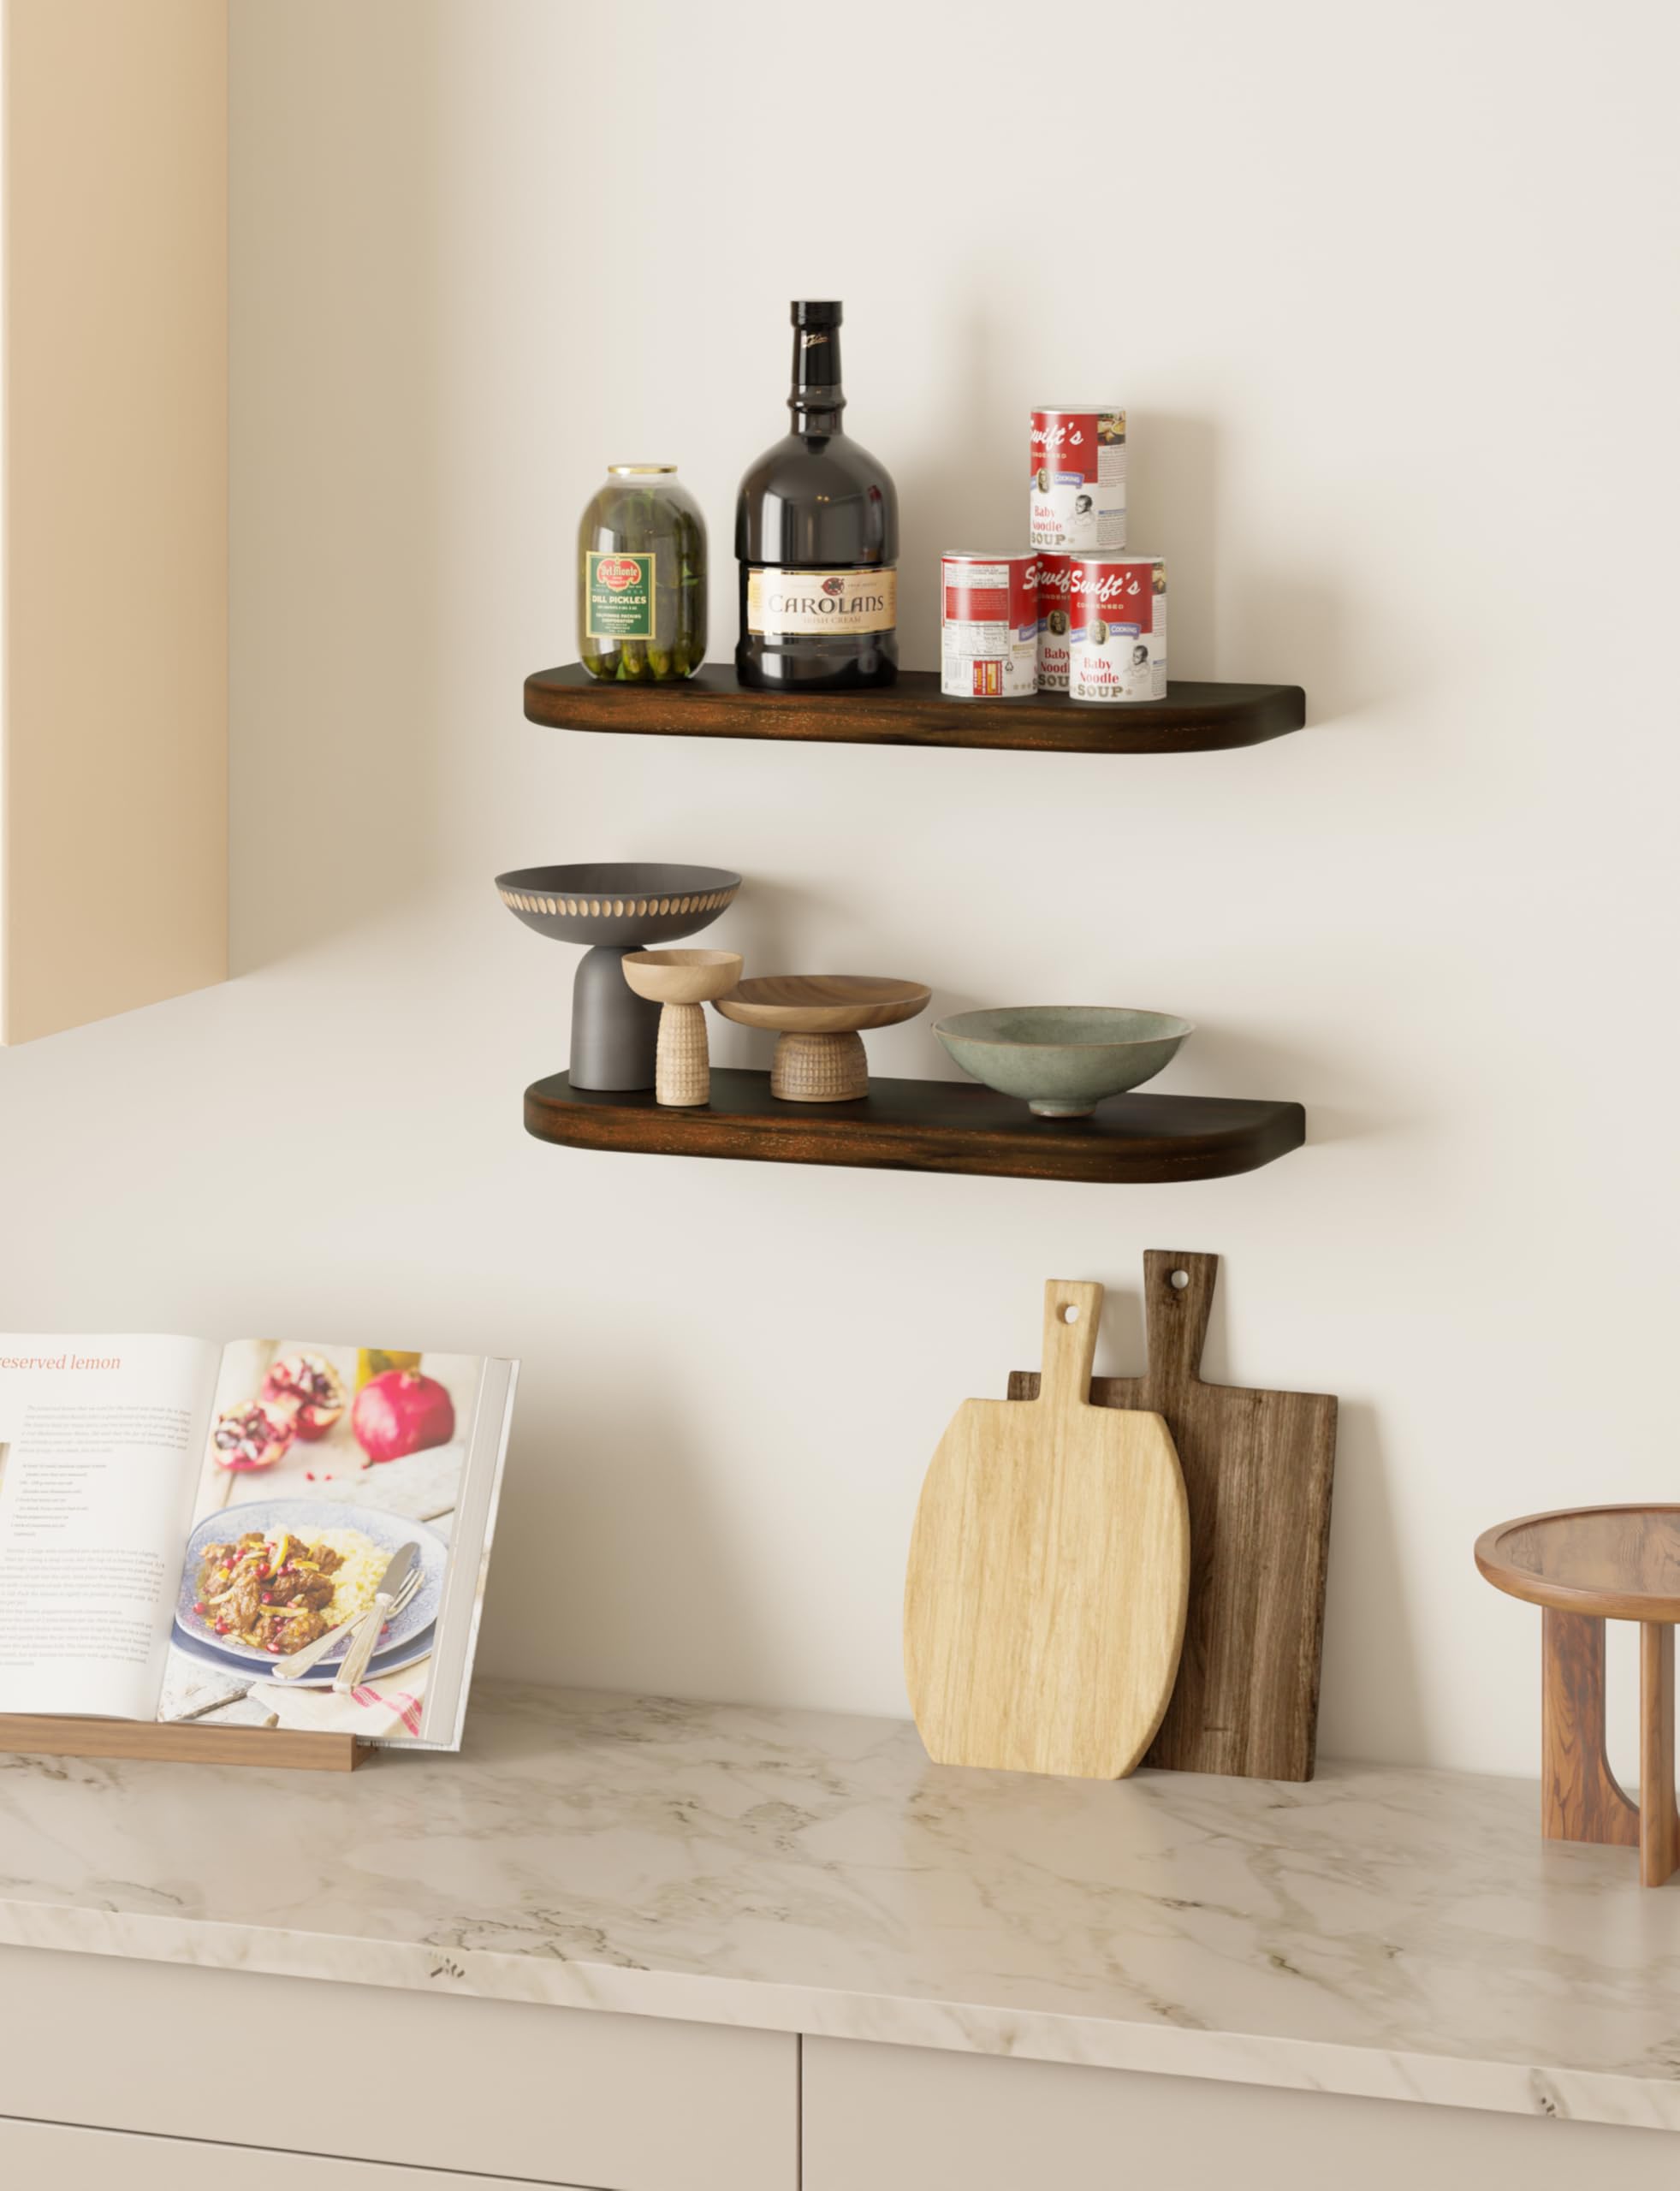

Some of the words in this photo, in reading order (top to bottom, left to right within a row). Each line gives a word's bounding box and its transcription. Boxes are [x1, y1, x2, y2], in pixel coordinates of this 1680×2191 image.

[1071, 570, 1141, 603] Swift's
[608, 596, 646, 604] PICKLES
[1083, 657, 1113, 671] Baby
[1037, 674, 1070, 687] SOU
[1079, 671, 1119, 684] Noodle
[1077, 684, 1124, 698] SOUP
[0, 1354, 67, 1369] eserved
[71, 1354, 121, 1369] lemon
